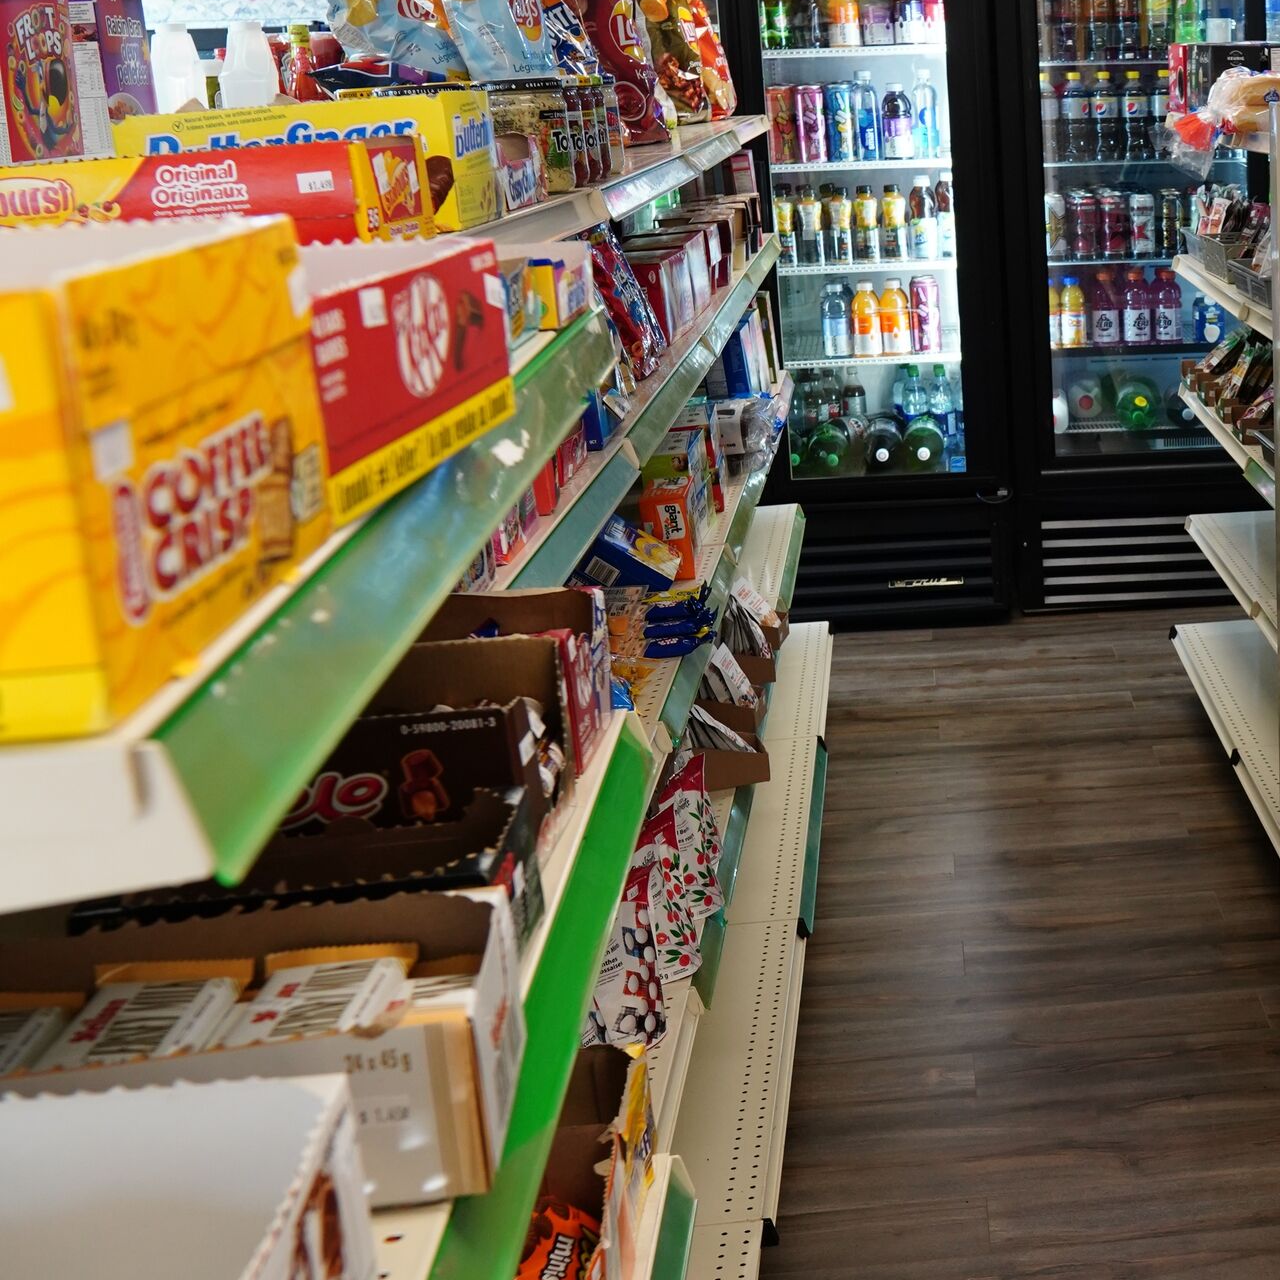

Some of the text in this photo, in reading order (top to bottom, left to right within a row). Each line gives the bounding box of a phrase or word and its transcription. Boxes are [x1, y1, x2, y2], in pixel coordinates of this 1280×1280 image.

[147, 117, 417, 157] Btterfinger
[158, 164, 234, 186] Original
[155, 184, 245, 206] Originaux
[664, 504, 683, 534] giant
[154, 485, 257, 592] CRISP
[583, 1035, 596, 1048] cotch
